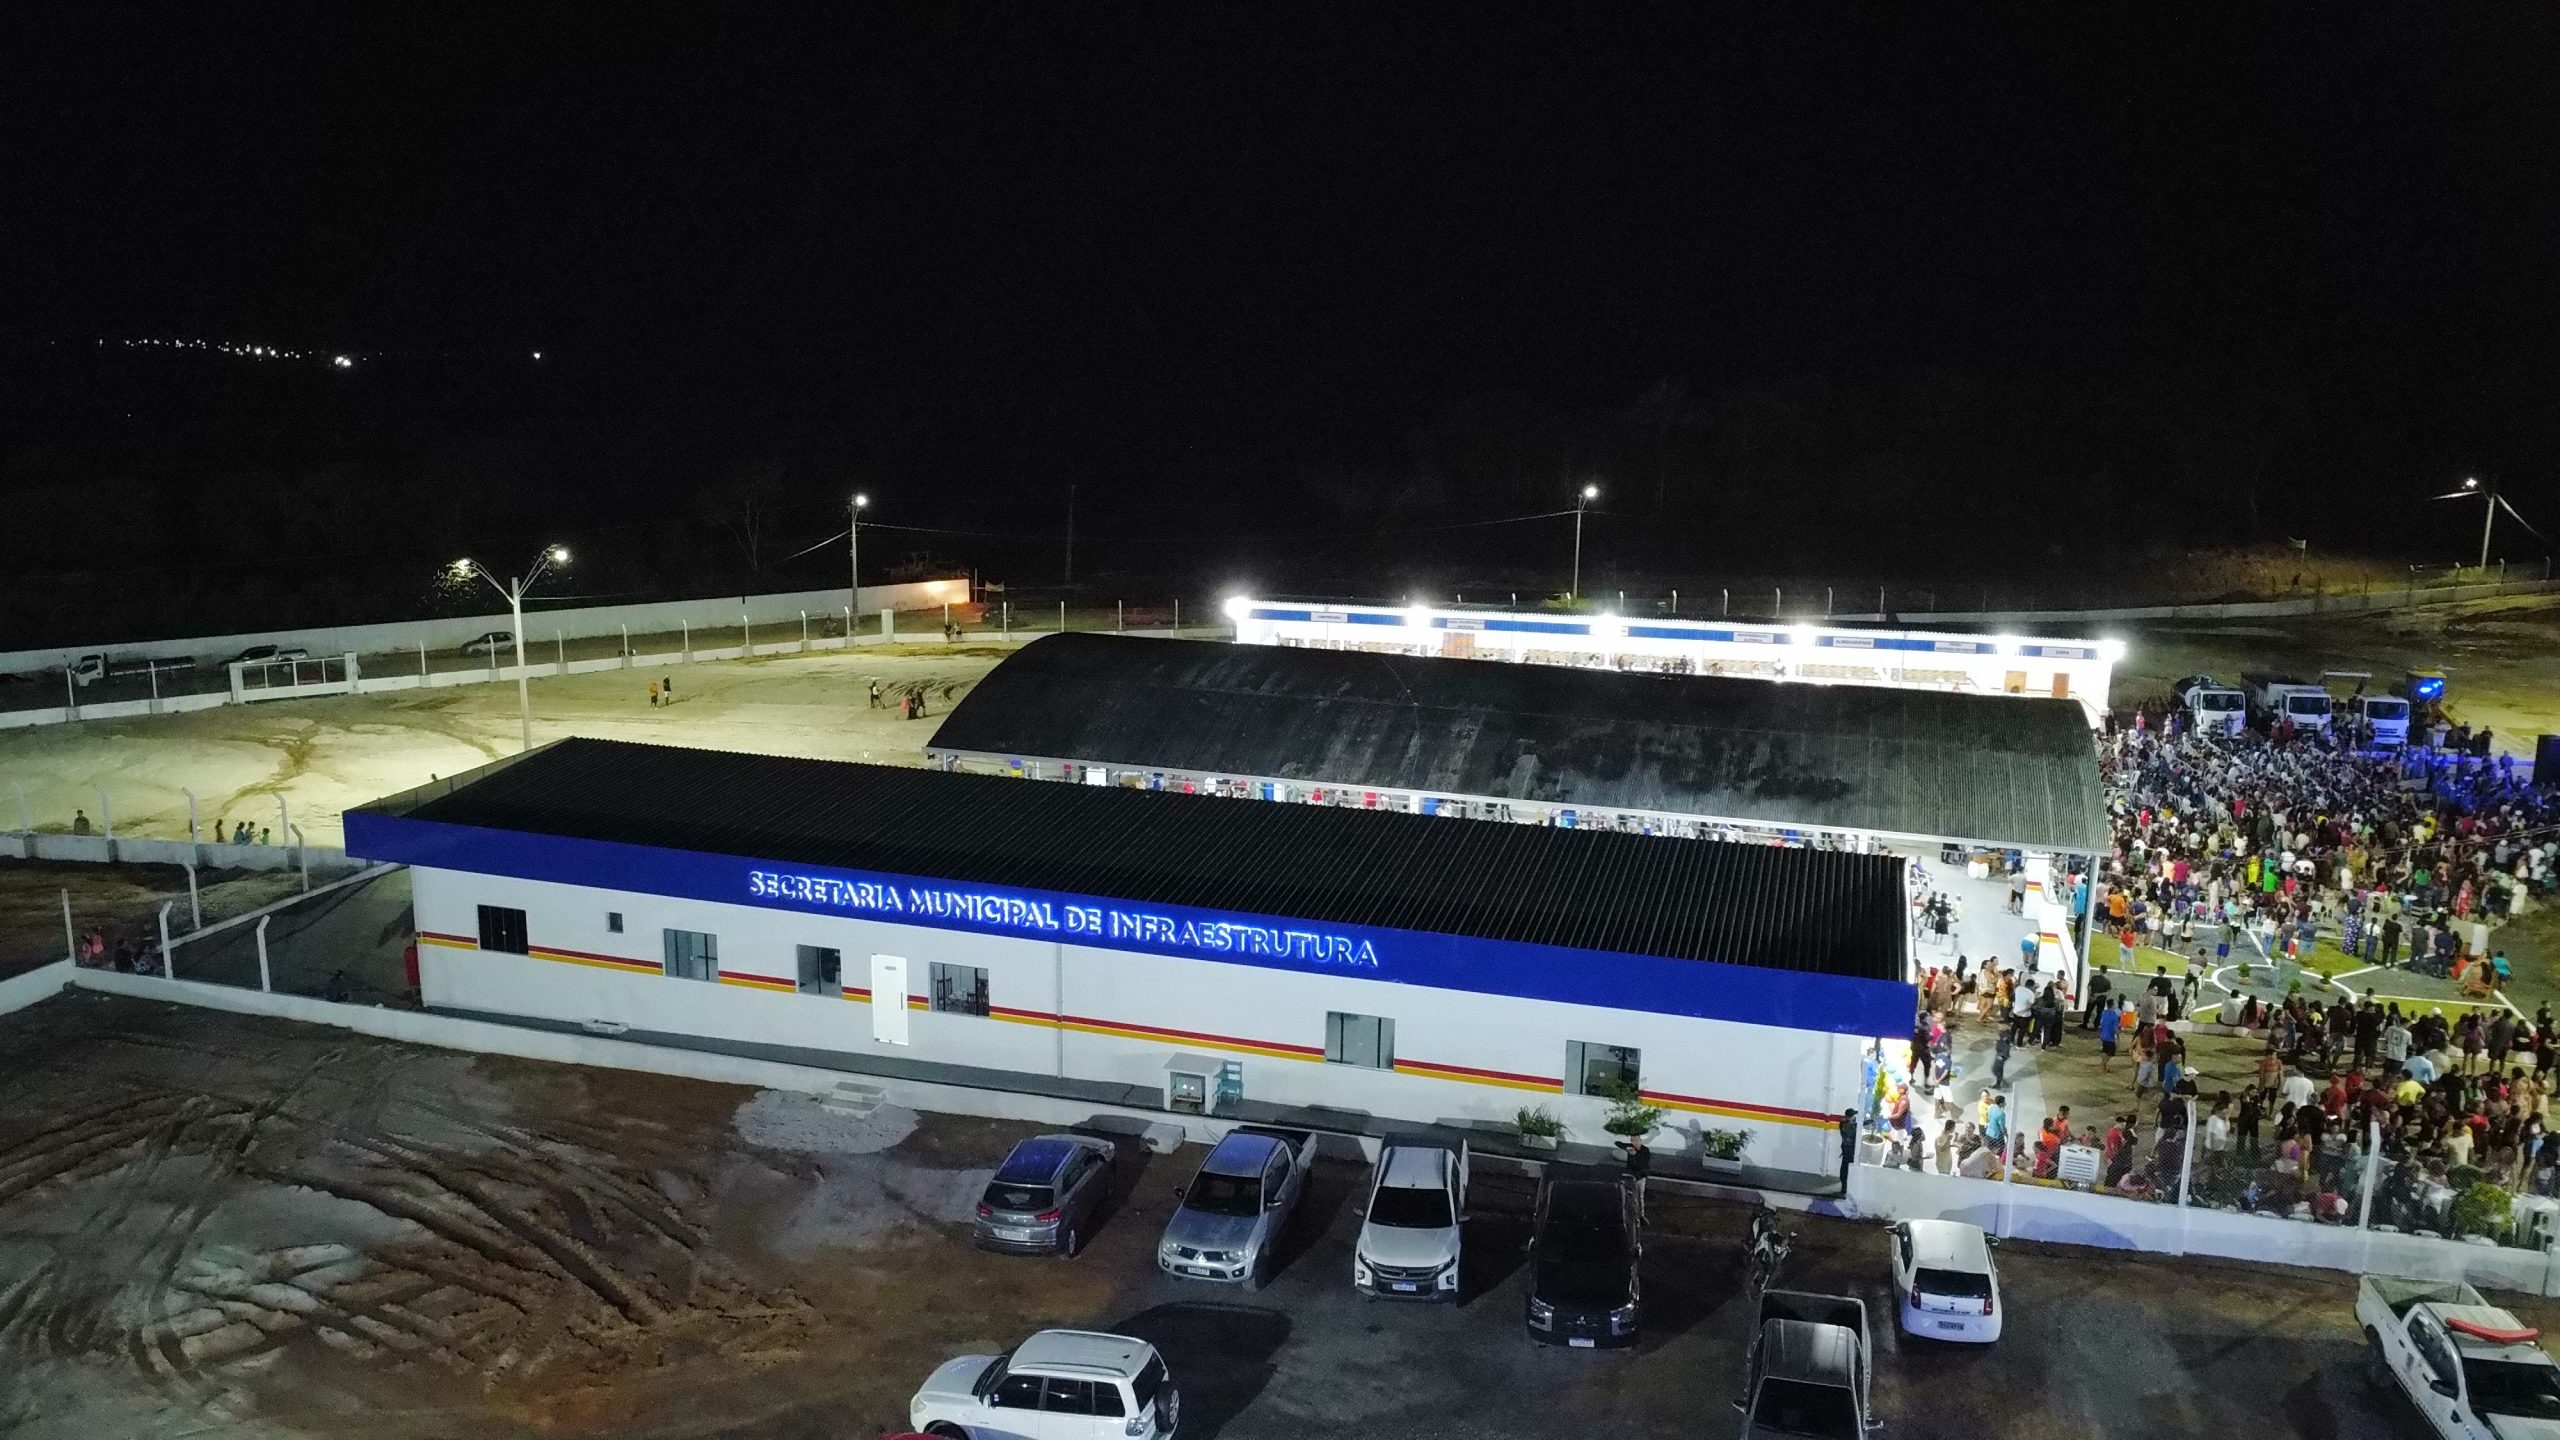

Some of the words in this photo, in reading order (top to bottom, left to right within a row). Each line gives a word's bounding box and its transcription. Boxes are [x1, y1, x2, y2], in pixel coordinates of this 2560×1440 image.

[750, 870, 904, 912] SECRETARIA
[908, 887, 1060, 930] MUNICIPAL
[1063, 904, 1102, 936] DE
[1108, 910, 1379, 969] INFRAESTRUTURA
